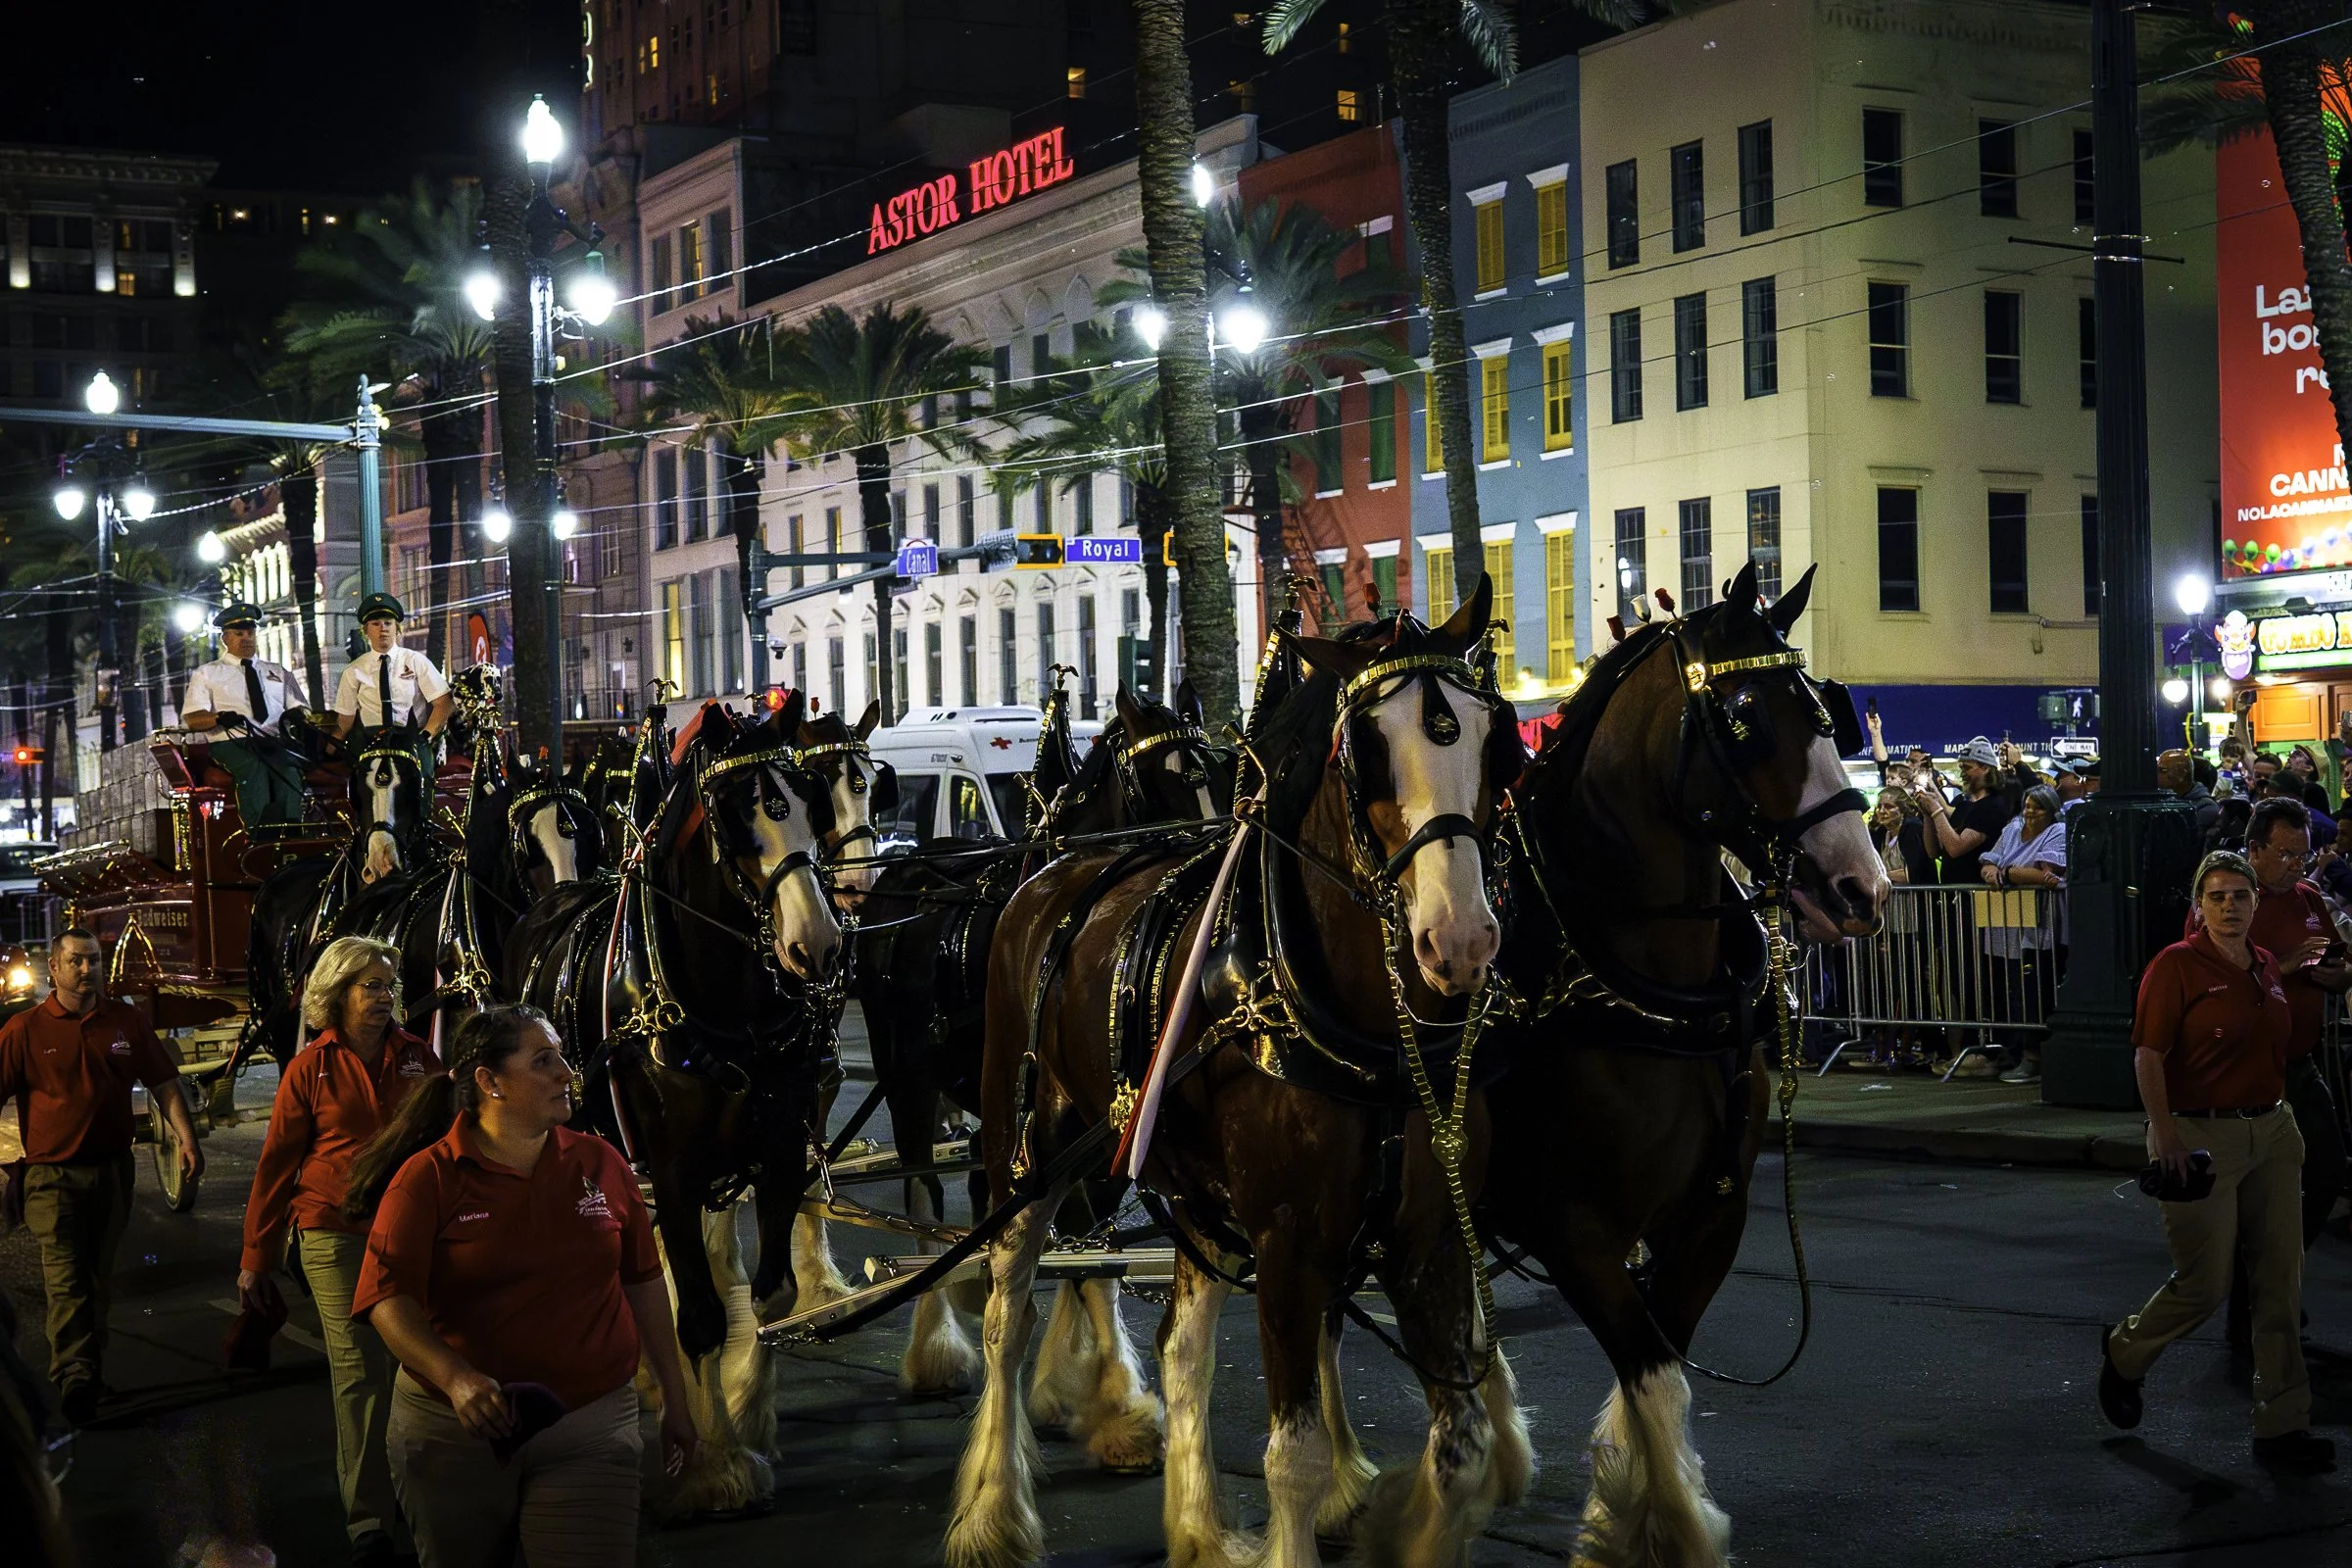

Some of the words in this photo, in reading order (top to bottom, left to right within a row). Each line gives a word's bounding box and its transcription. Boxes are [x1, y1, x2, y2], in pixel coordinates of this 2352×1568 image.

[867, 174, 960, 255] ASTOR
[969, 126, 1074, 214] HOTEL
[906, 549, 930, 574] Canal
[1082, 540, 1129, 562] Royal
[2258, 612, 2336, 656] GUMBO
[1943, 743, 1969, 754] MAP
